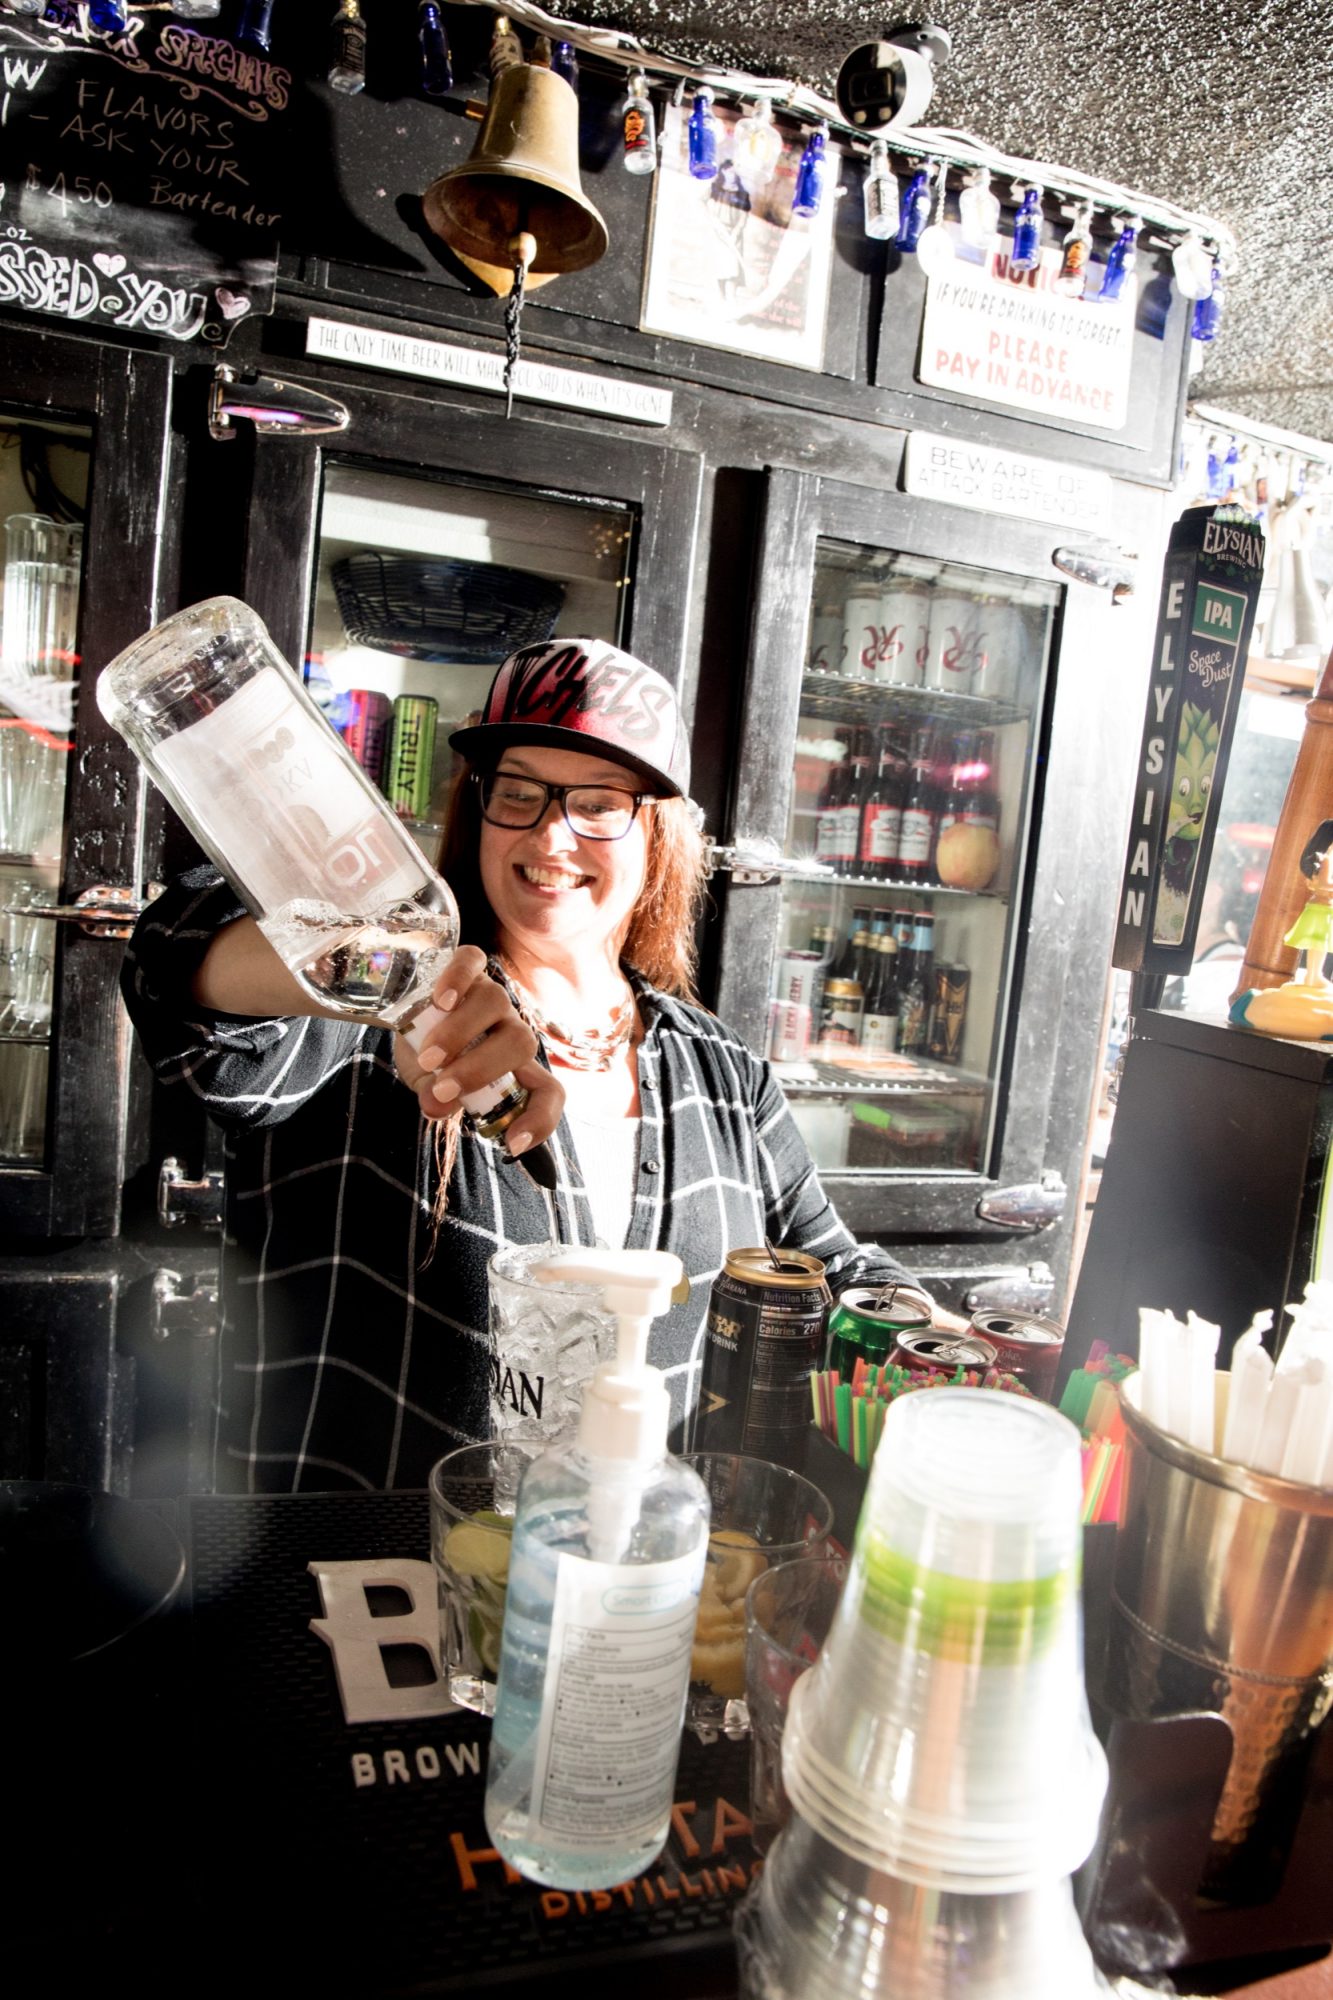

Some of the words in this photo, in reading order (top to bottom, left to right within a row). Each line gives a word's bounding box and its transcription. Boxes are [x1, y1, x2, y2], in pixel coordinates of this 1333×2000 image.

[76, 78, 234, 149] FLAVORS
[60, 114, 135, 153] ASK
[150, 138, 249, 186] YOUR
[150, 175, 281, 227] Bartender
[0, 242, 99, 319] SSED
[114, 274, 207, 341] YOU
[991, 252, 1062, 296] NOTIC
[936, 281, 949, 302] IF
[952, 284, 996, 316] YOU'RE
[997, 296, 1056, 332] DRINKING
[1060, 313, 1075, 336] TO
[319, 326, 340, 350] THE
[344, 332, 375, 357] ONLY
[380, 338, 408, 363] TIME
[412, 344, 440, 370] BEER
[444, 351, 471, 377] WILL
[476, 358, 505, 383] MAK
[537, 371, 559, 394] SAD
[562, 376, 573, 396] IS
[576, 379, 608, 404] WHEN
[610, 386, 632, 409] IT'S
[634, 391, 665, 417] GONE
[988, 330, 1068, 373] PLEASE
[935, 348, 980, 382] PAY
[987, 362, 1010, 387] IN
[1015, 368, 1115, 413] ADVANCE
[917, 467, 985, 497] ATTACK
[991, 482, 1101, 520] BARTENDER
[930, 446, 1045, 487] BEWARE
[1058, 473, 1089, 495] OF
[1203, 520, 1265, 570] ELYSIAN
[1217, 553, 1247, 569] BREWING
[1203, 600, 1233, 629] IPA
[1188, 650, 1221, 676] Space
[1202, 662, 1232, 688] Dust
[397, 714, 420, 794] TRULY
[1124, 582, 1184, 928] ELYSIAN
[763, 1290, 800, 1303] Nutrition
[802, 1291, 821, 1302] Facts
[712, 1332, 738, 1353] DRINK
[759, 1323, 797, 1336] Calories
[804, 1322, 821, 1336] 270
[351, 1741, 482, 1789] BROW
[541, 1858, 765, 1920] DISTILLIN
